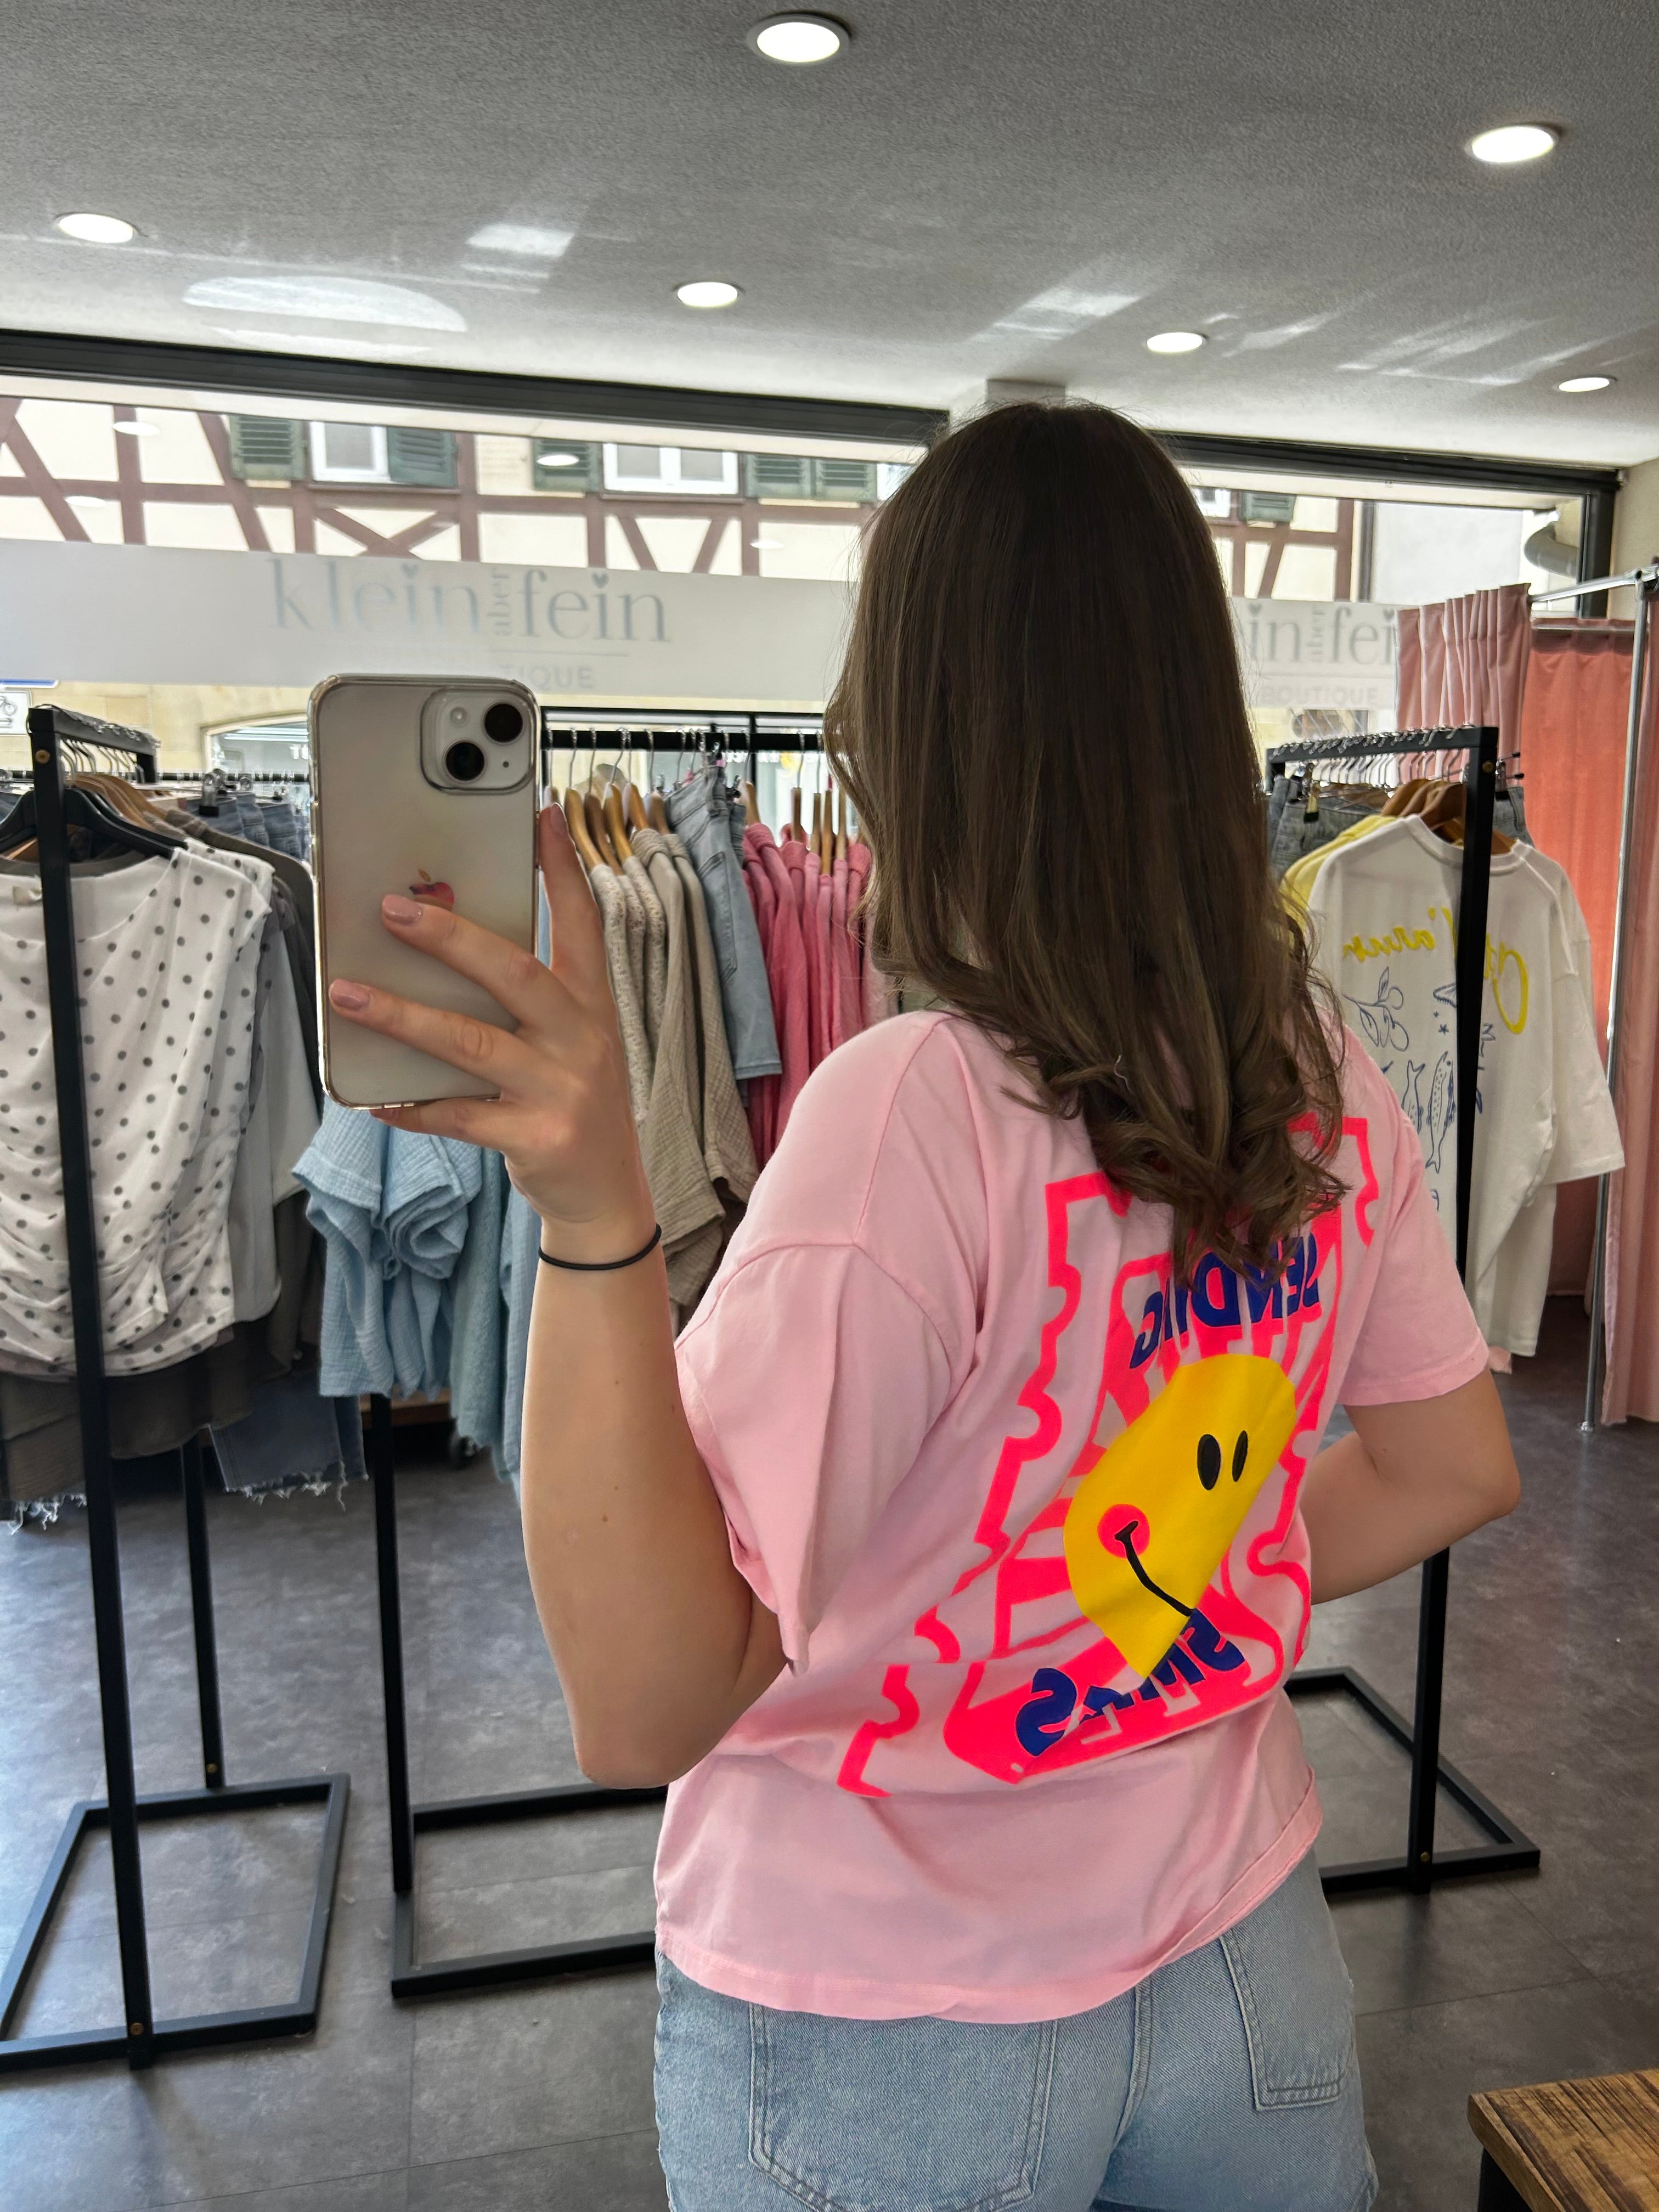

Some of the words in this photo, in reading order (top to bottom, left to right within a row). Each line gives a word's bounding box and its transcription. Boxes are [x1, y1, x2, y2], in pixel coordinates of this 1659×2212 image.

[266, 557, 482, 635] klein
[518, 569, 672, 642] fein
[1329, 605, 1395, 665] fei
[499, 663, 593, 691] TIQUE
[1262, 685, 1378, 706] BOUTIQUE
